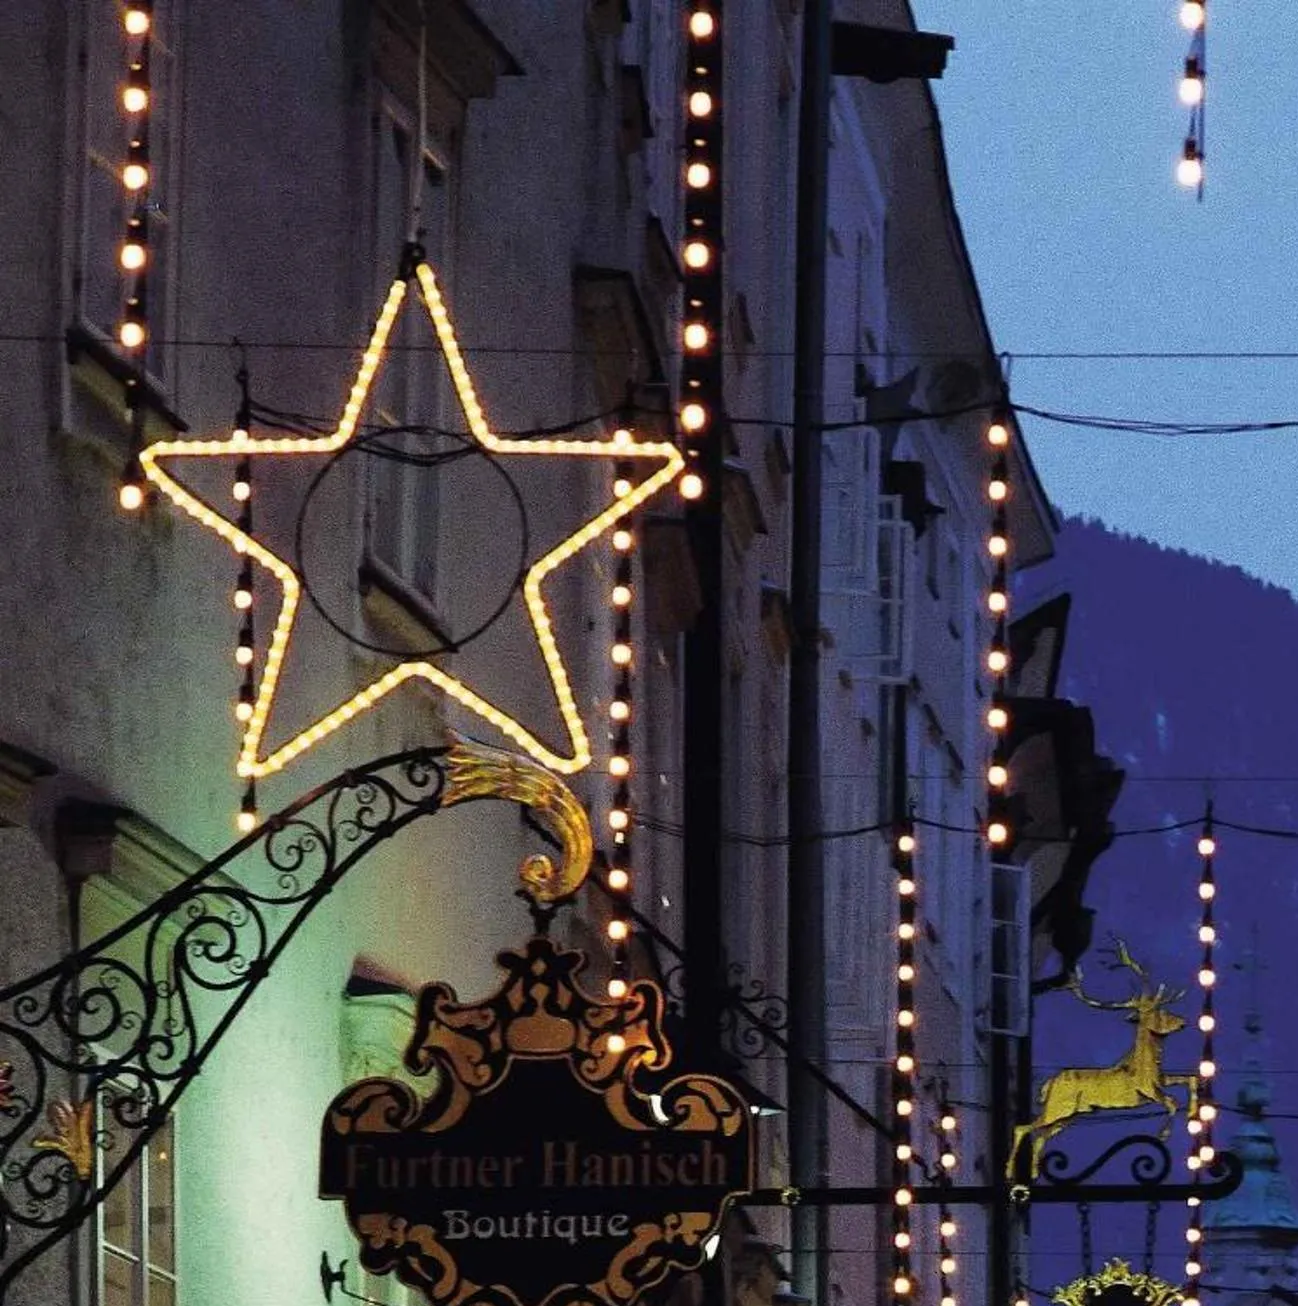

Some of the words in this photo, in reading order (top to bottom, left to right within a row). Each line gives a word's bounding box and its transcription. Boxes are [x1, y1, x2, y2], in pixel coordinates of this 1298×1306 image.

[344, 1142, 524, 1190] Furtner
[542, 1139, 728, 1189] Hanisch
[442, 1209, 630, 1245] Boutique
